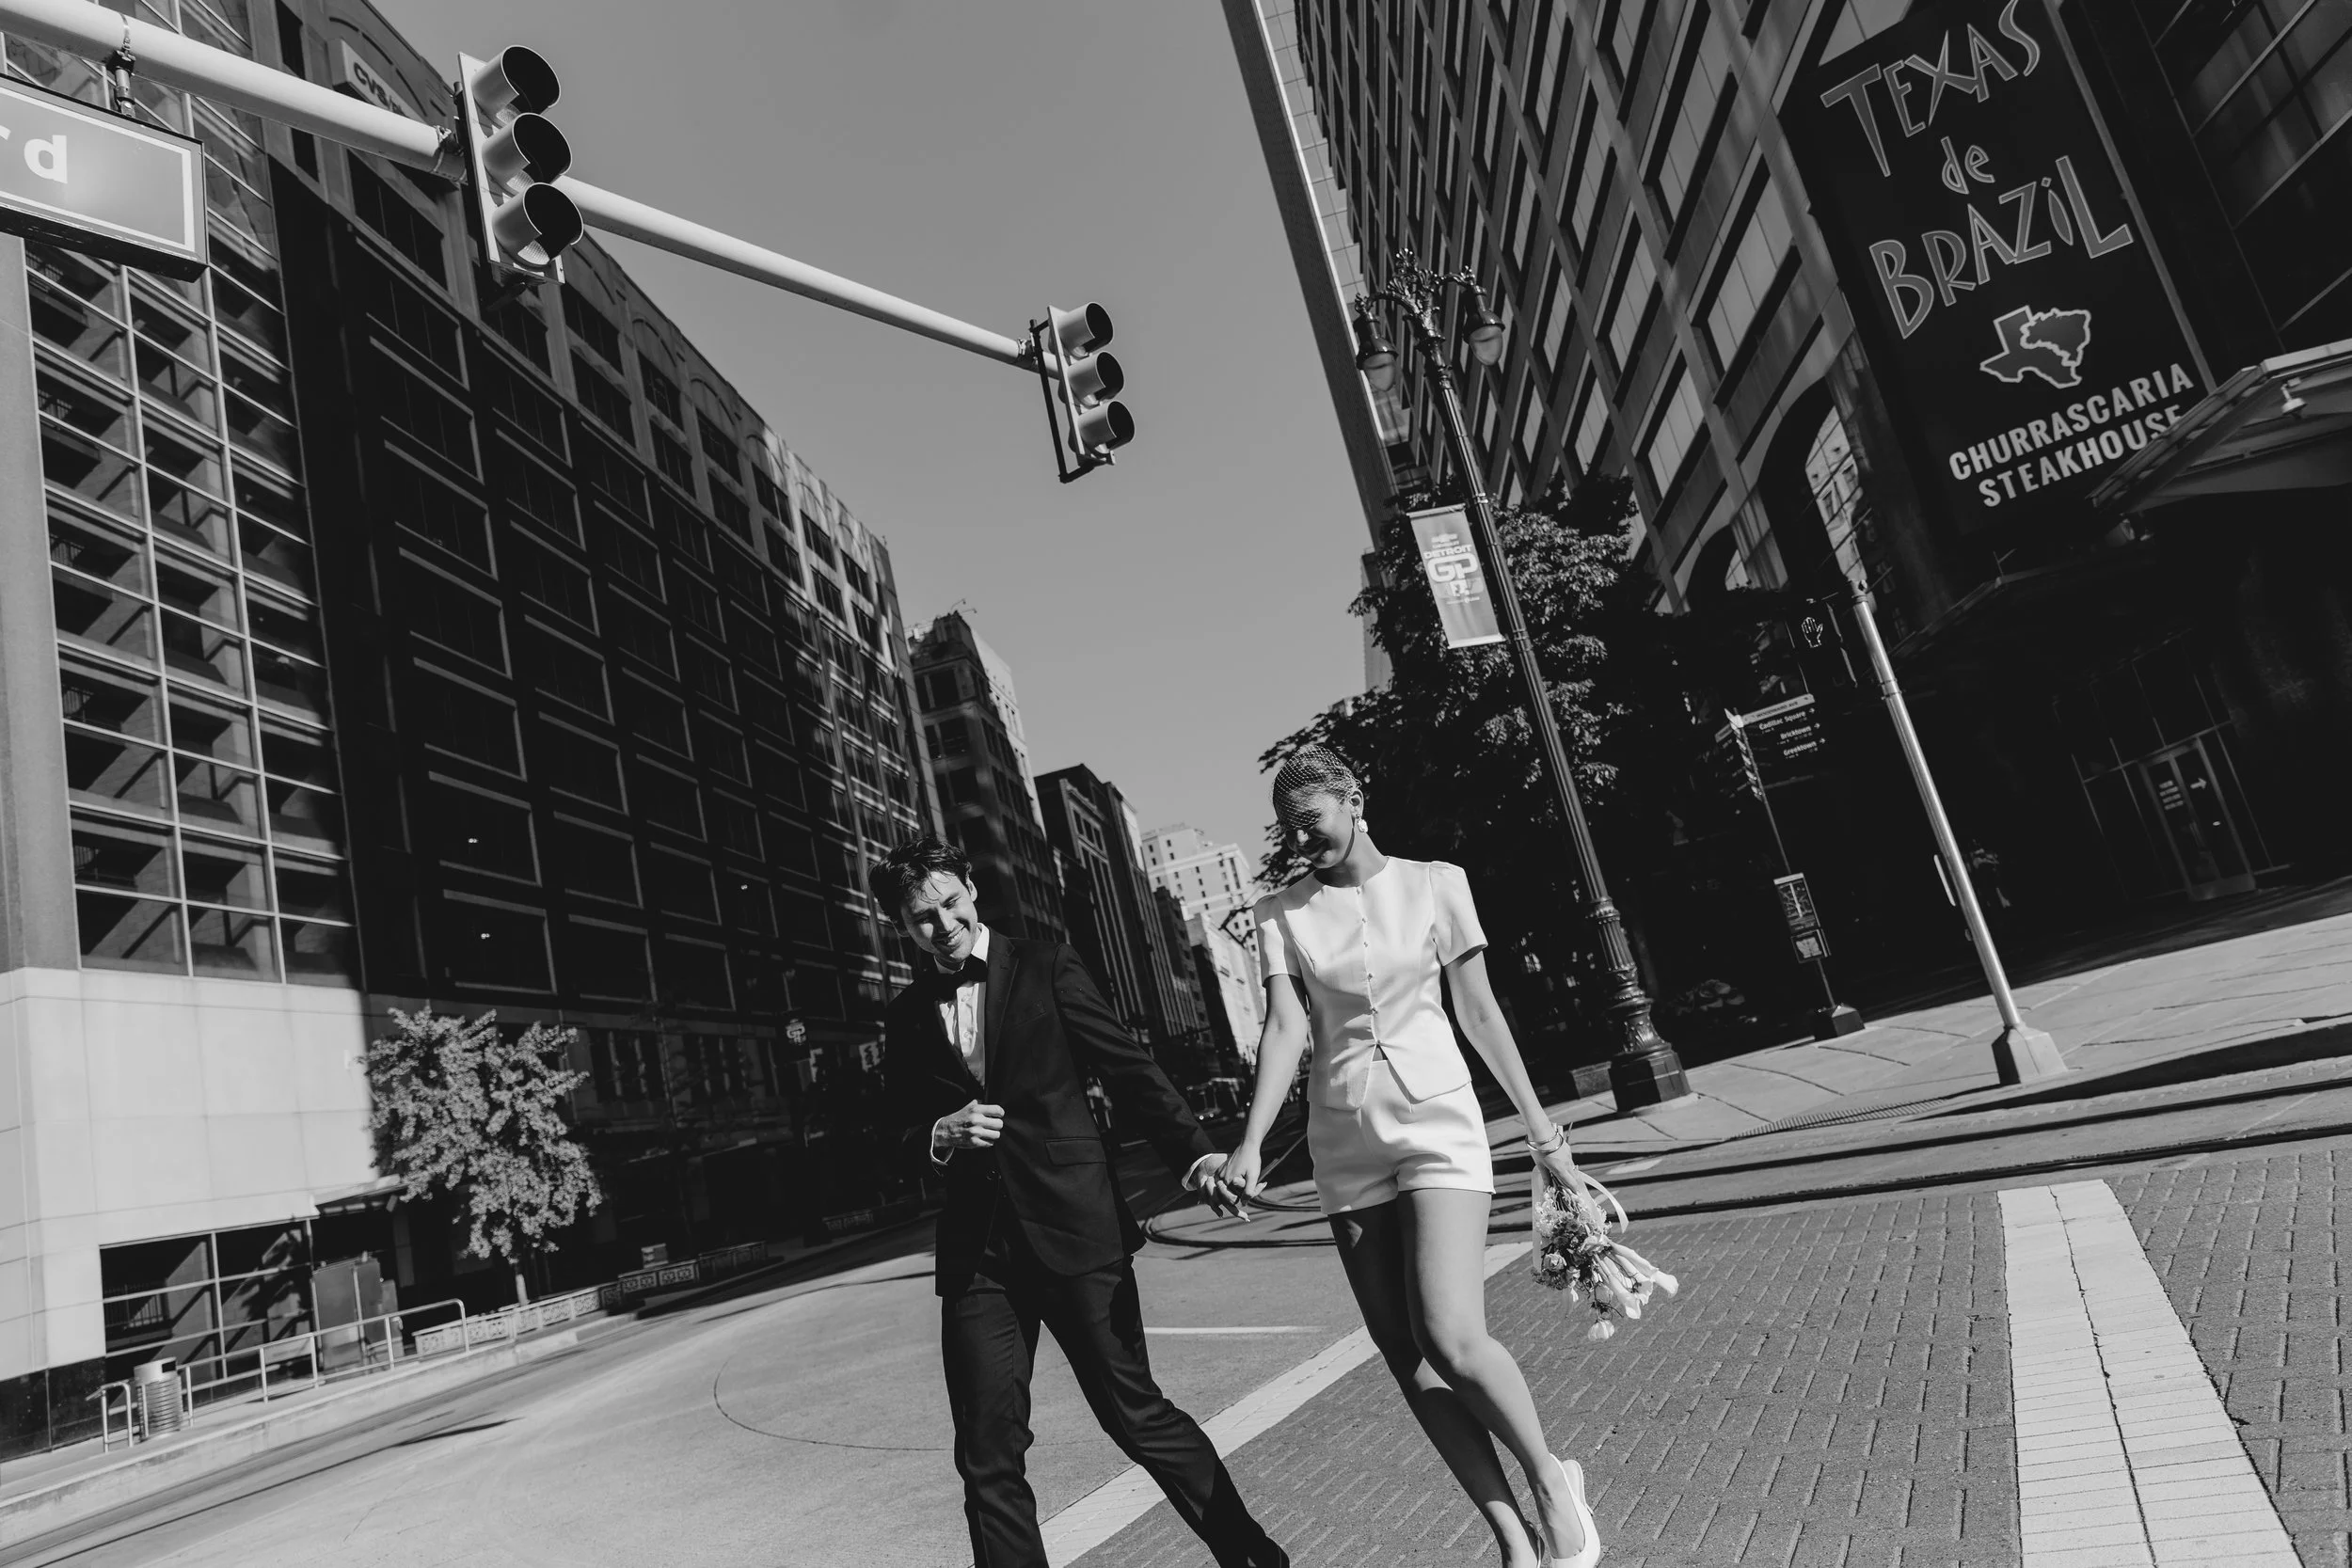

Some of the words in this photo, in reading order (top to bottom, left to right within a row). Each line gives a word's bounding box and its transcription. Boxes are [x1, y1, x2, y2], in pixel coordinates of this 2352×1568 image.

[1820, 0, 2041, 177] TEXAS
[1941, 136, 1994, 194] de
[1948, 362, 2195, 481] CHURRASCARIA
[1423, 544, 1472, 560] DETROIT
[1427, 552, 1479, 582] GP
[1758, 718, 1784, 731] Cadillac
[1784, 710, 1806, 722] Square
[1780, 725, 1812, 740] Bricktown
[1783, 741, 1817, 756] Greektown
